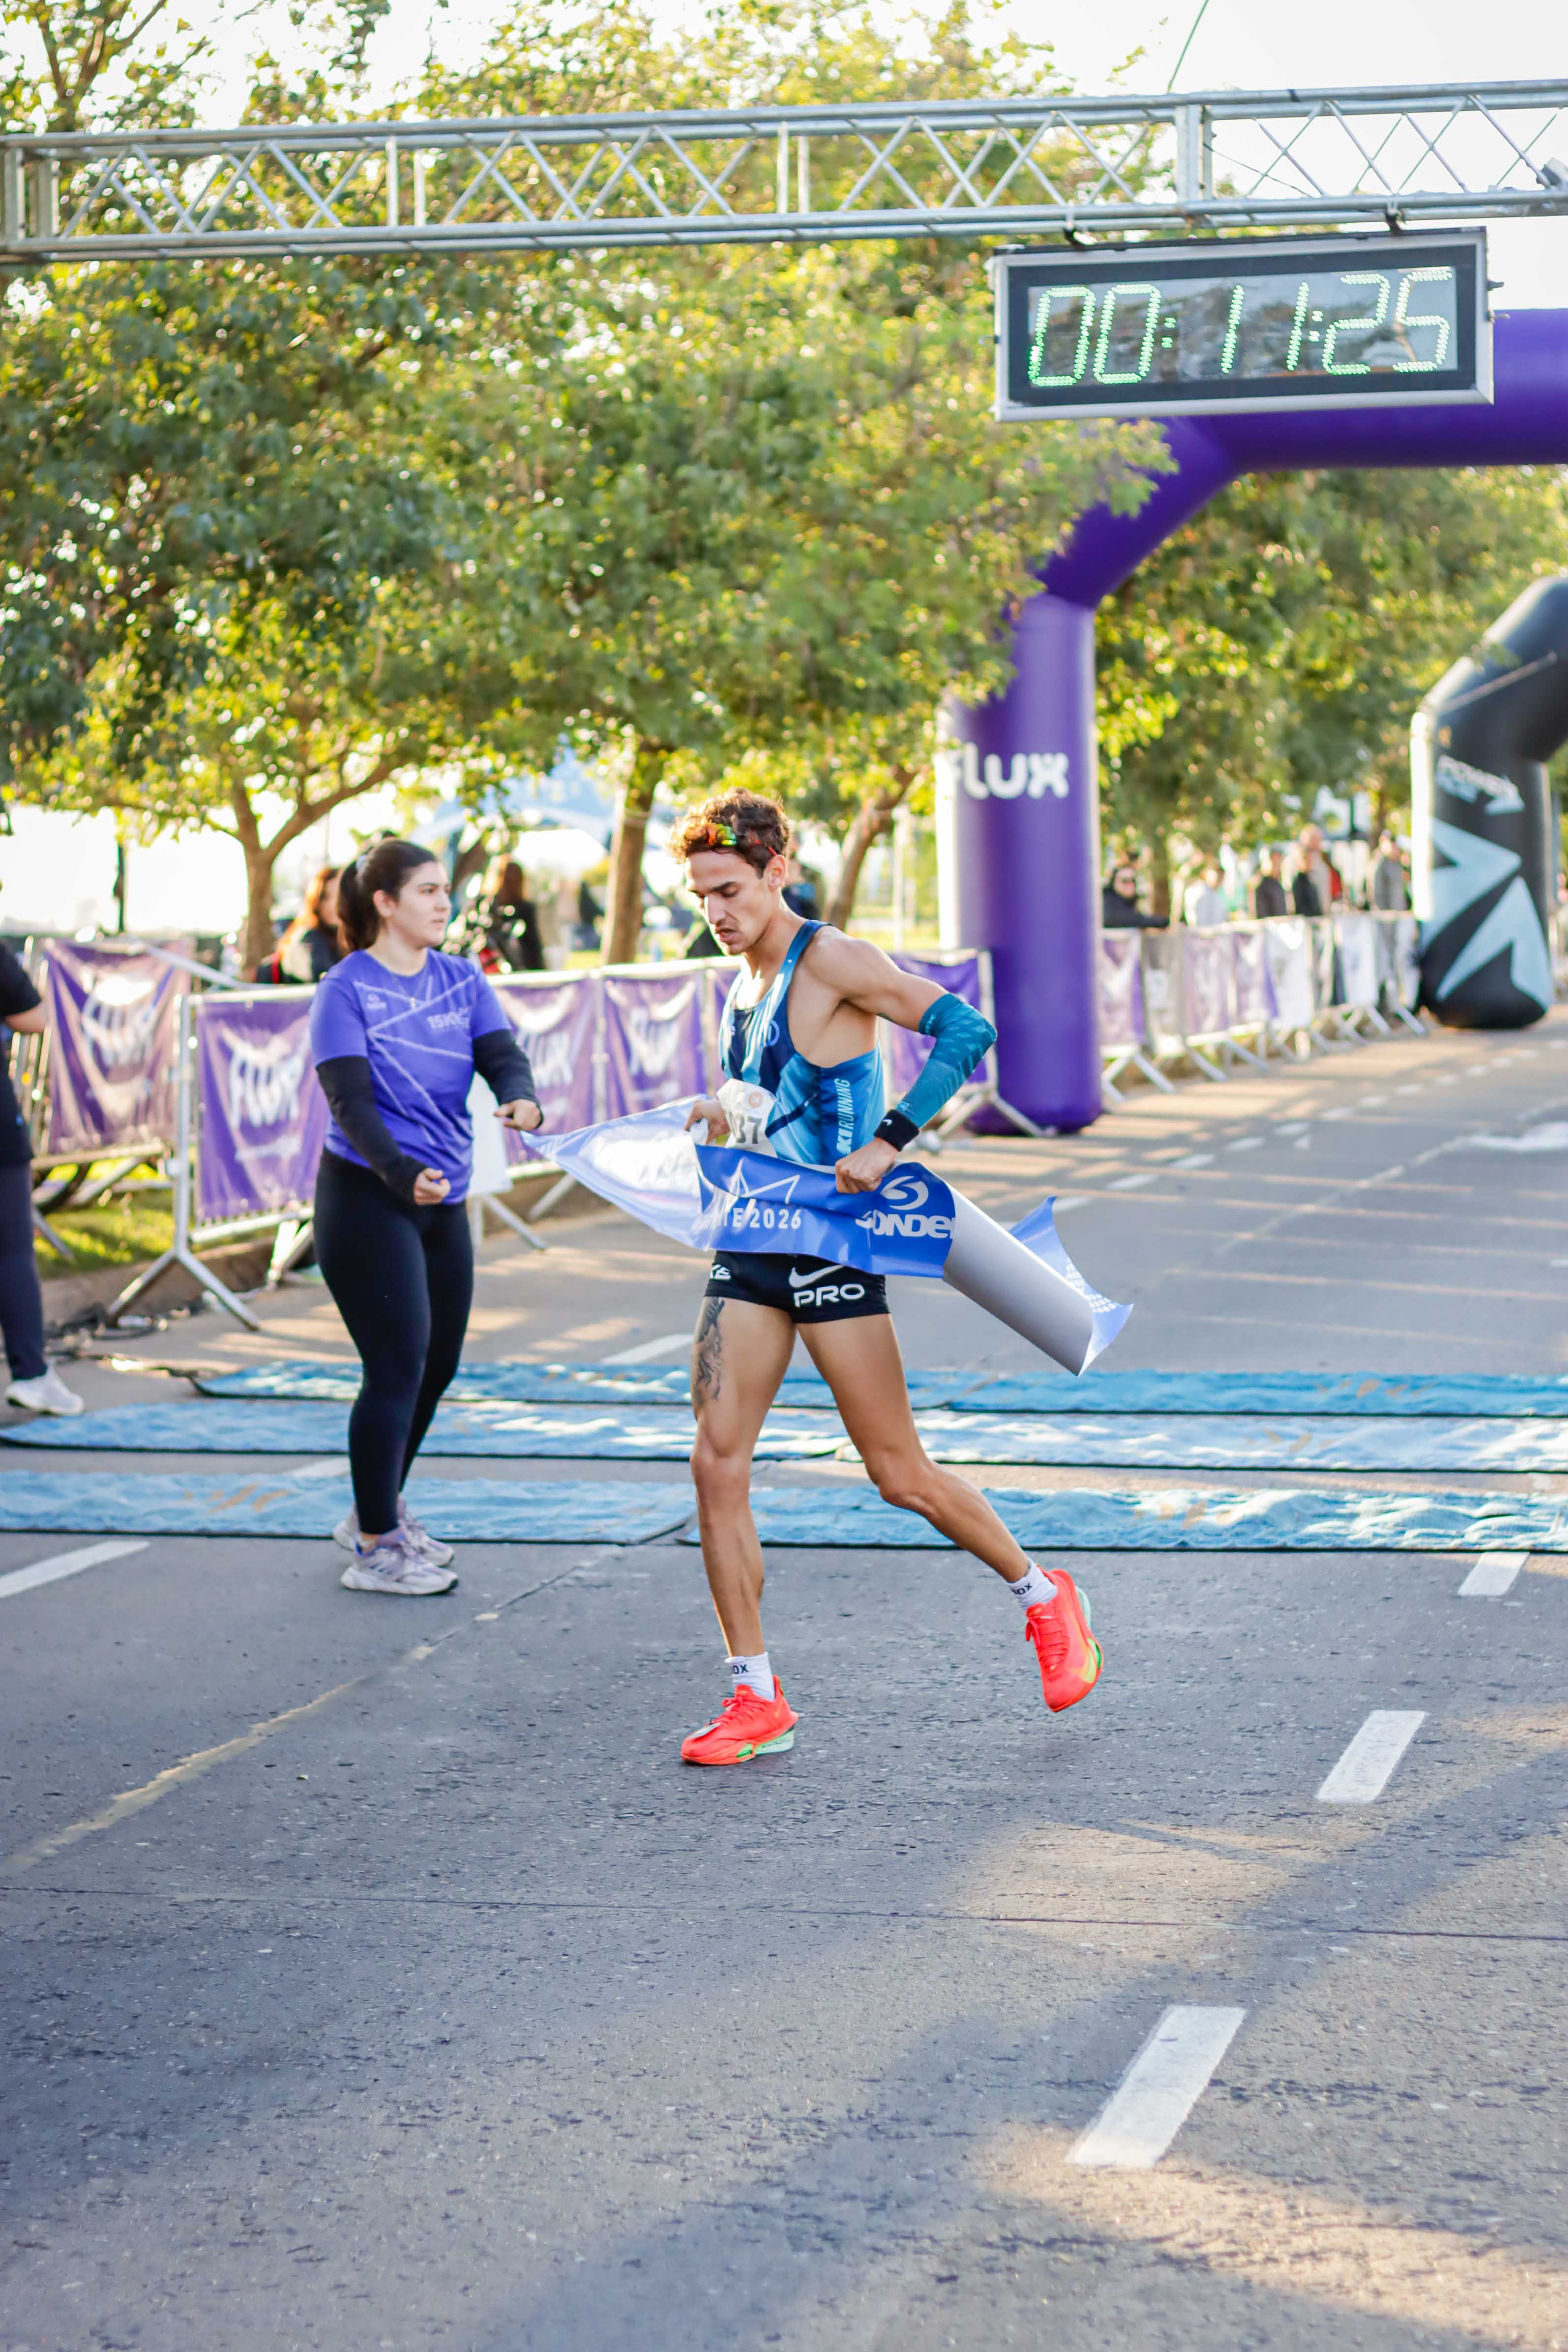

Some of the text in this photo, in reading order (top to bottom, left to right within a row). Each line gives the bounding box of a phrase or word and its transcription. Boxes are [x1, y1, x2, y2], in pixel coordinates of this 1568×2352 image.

[1028, 270, 1452, 387] 00:11:25
[749, 1207, 801, 1229] 2026
[794, 1283, 865, 1308] PRO
